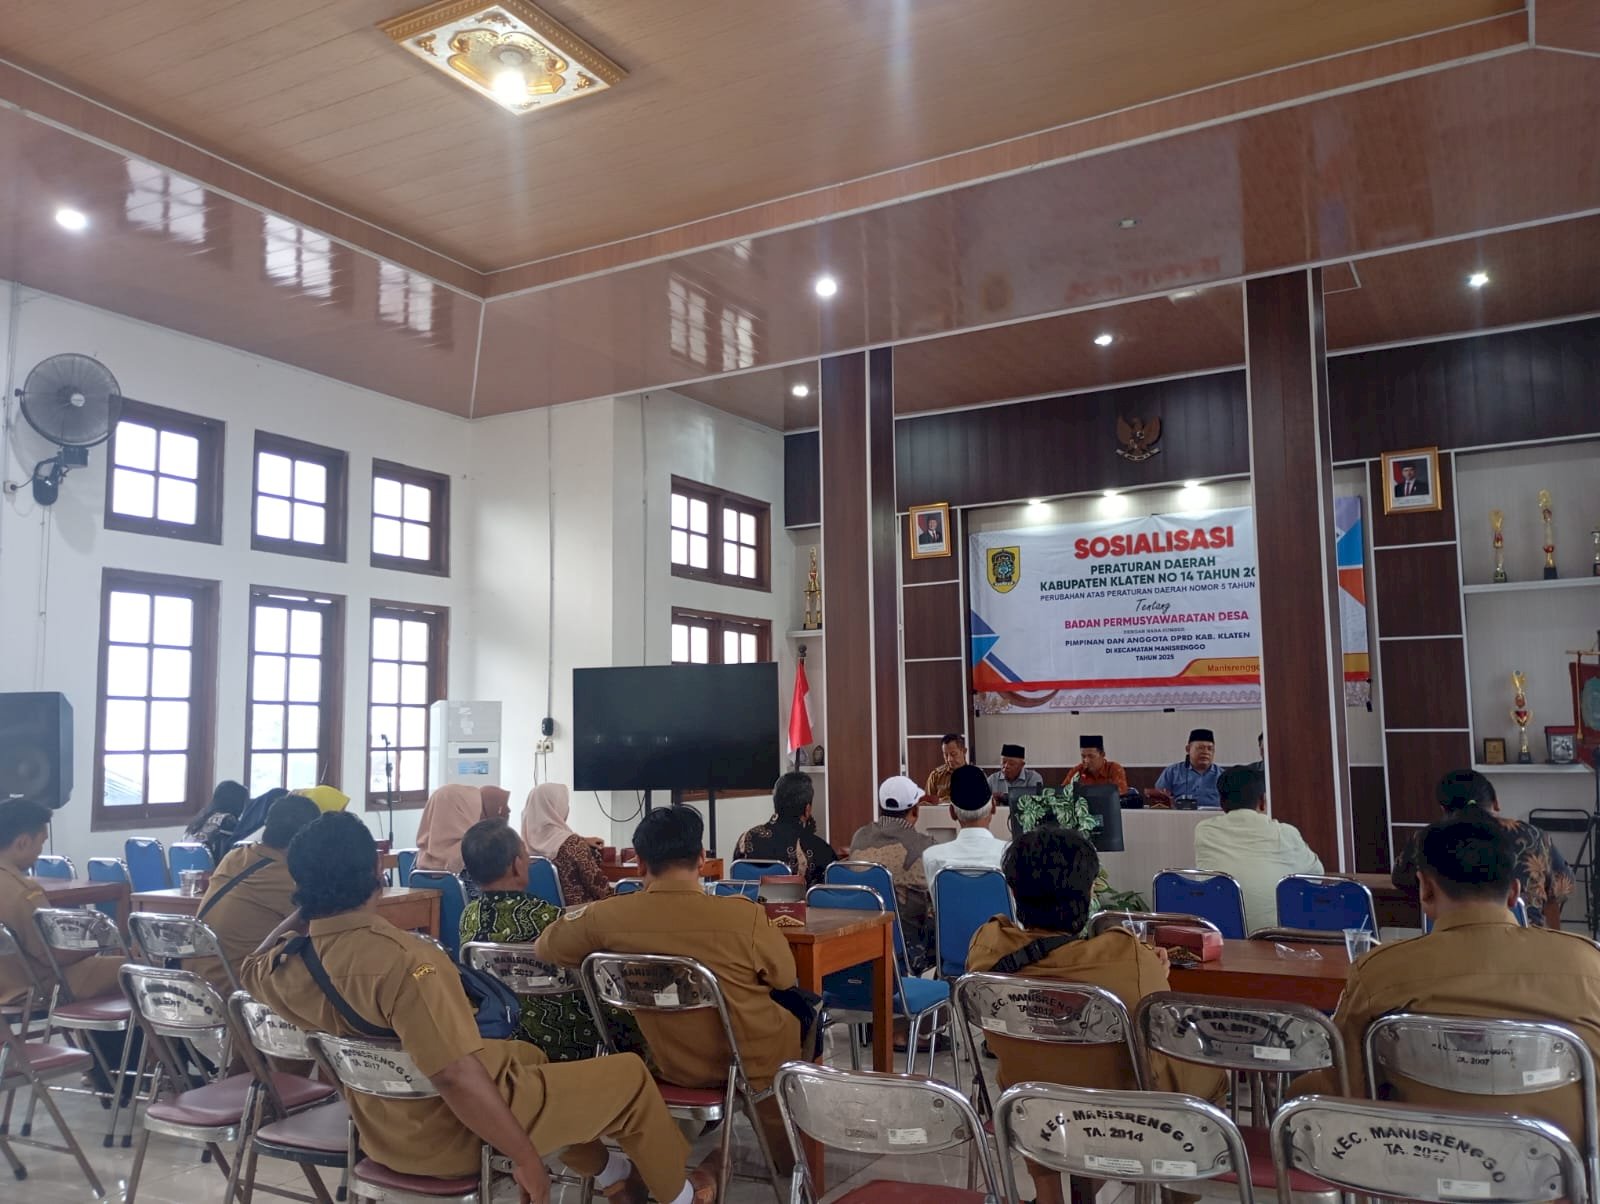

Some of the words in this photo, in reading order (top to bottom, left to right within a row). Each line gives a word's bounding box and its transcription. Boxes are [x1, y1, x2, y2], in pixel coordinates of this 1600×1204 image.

[1074, 526, 1234, 560] SOSIALISASI
[1090, 559, 1161, 575] PERATURAN
[1164, 556, 1216, 570] DAERAH
[1040, 576, 1107, 592] KABUPATEN
[1110, 573, 1154, 587] KLATEN
[1158, 572, 1177, 584] NO
[1180, 570, 1194, 582] 14
[1197, 568, 1240, 581] TAHUN
[1040, 592, 1085, 601] PERUBAHAN
[1086, 590, 1105, 599] ATAS
[1107, 588, 1153, 597] PERATURAN
[1154, 585, 1188, 594] DAERAH
[1189, 583, 1219, 592] NOMOR
[1221, 582, 1226, 590] 5
[1228, 581, 1255, 590] TAHUN
[1135, 598, 1171, 614] Tentang
[1064, 619, 1101, 629] BADAN
[1103, 612, 1216, 627] PERMUSYAWARATAN
[1218, 610, 1249, 621] DESA
[1065, 638, 1105, 646] PIMPINAN
[1106, 637, 1125, 645] DAN
[1126, 635, 1168, 644] ANGGOTA
[1170, 633, 1193, 642] DPRD
[1195, 632, 1215, 640] KAB.
[1218, 631, 1250, 639] KLATEN
[1113, 645, 1153, 653] KECAMATAN
[1154, 643, 1206, 651] MANISRENGGO
[1158, 653, 1175, 661] 2025
[990, 998, 1009, 1017] KEC.
[1040, 1114, 1071, 1142] KEC.
[1072, 1109, 1195, 1153] MANISRENGGO
[1083, 1127, 1106, 1138] TA.
[1109, 1127, 1144, 1143] 2014
[1331, 1130, 1368, 1160] KEC.
[1369, 1126, 1507, 1184] MANISRENGGO
